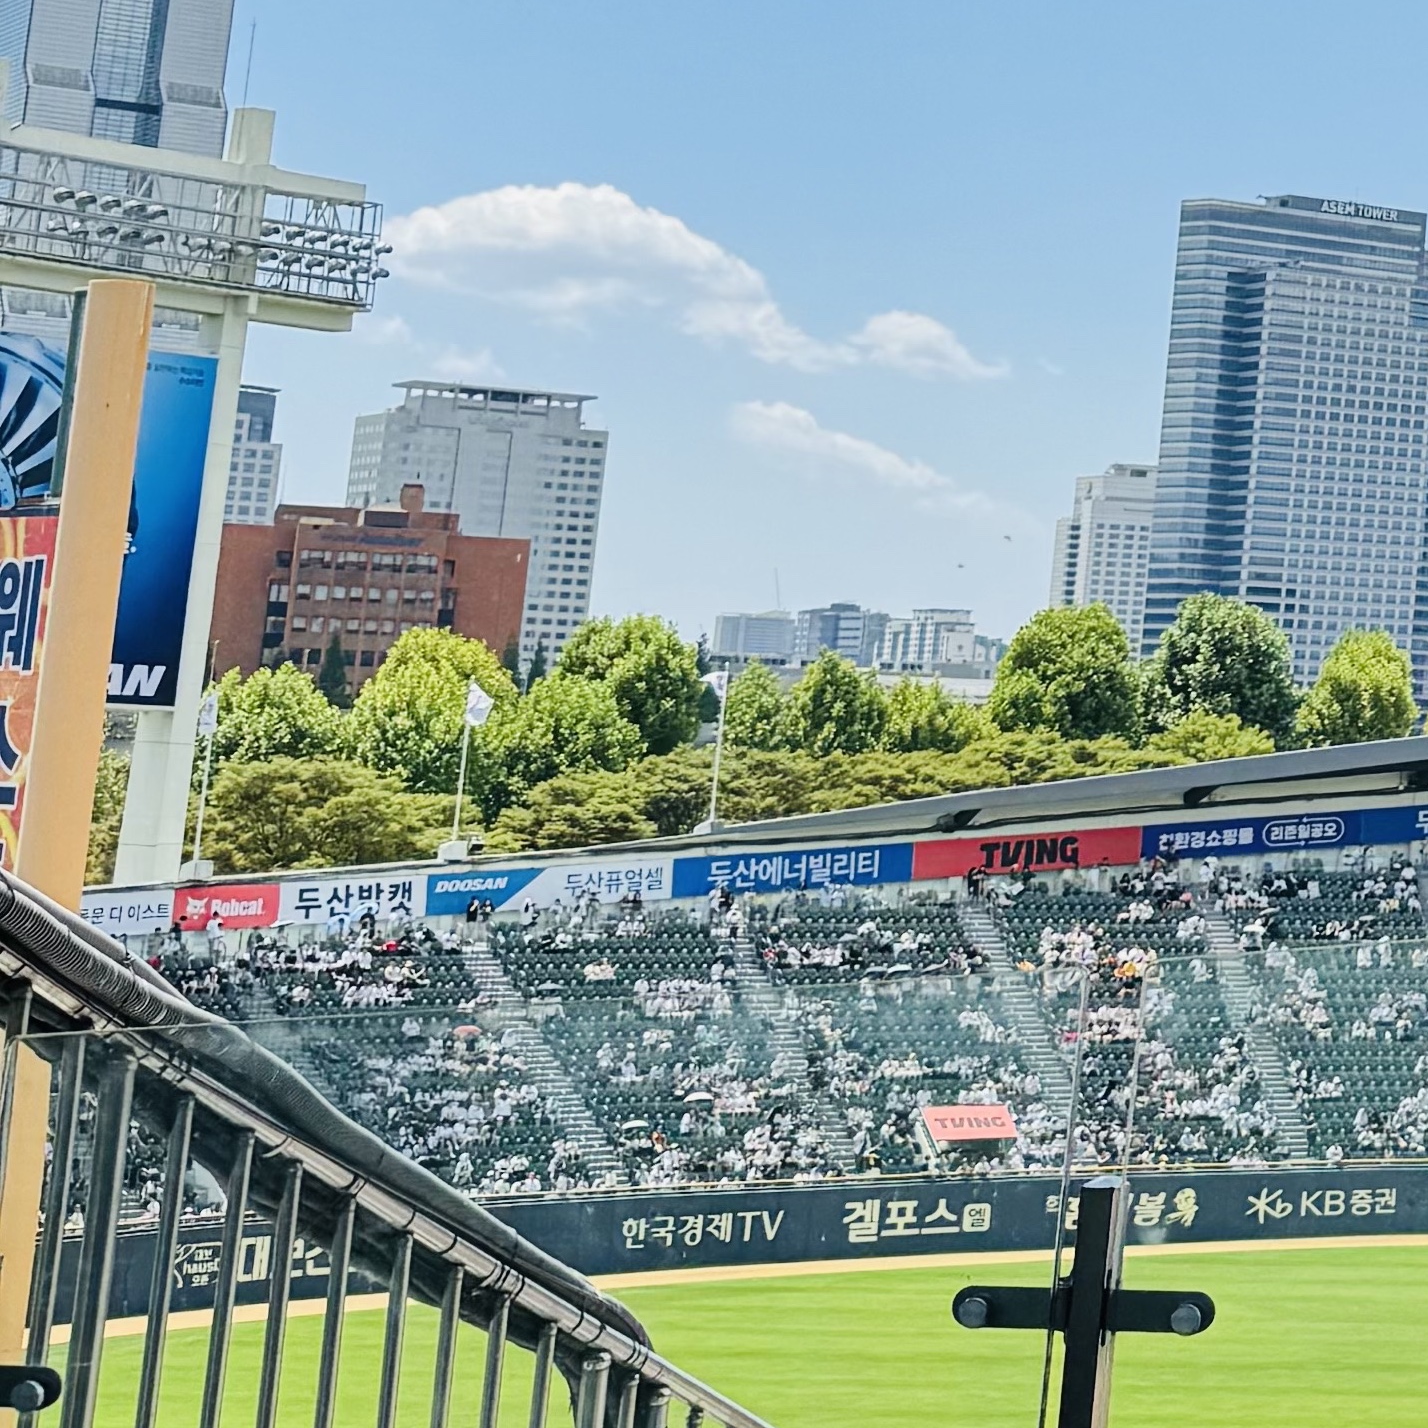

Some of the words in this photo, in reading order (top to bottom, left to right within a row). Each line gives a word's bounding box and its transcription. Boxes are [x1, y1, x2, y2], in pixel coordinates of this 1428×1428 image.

[1321, 200, 1355, 216] ASEM
[1357, 205, 1398, 222] TOWER
[980, 836, 1078, 869] TVING
[564, 867, 663, 896] 두산퓨얼셀
[706, 849, 880, 889] 두산에너빌리티
[434, 876, 508, 894] DOOSAN
[109, 906, 123, 923] 디
[127, 904, 170, 921] 이스트
[211, 897, 264, 918] Bobcat
[622, 1209, 785, 1249] 한국경제TV
